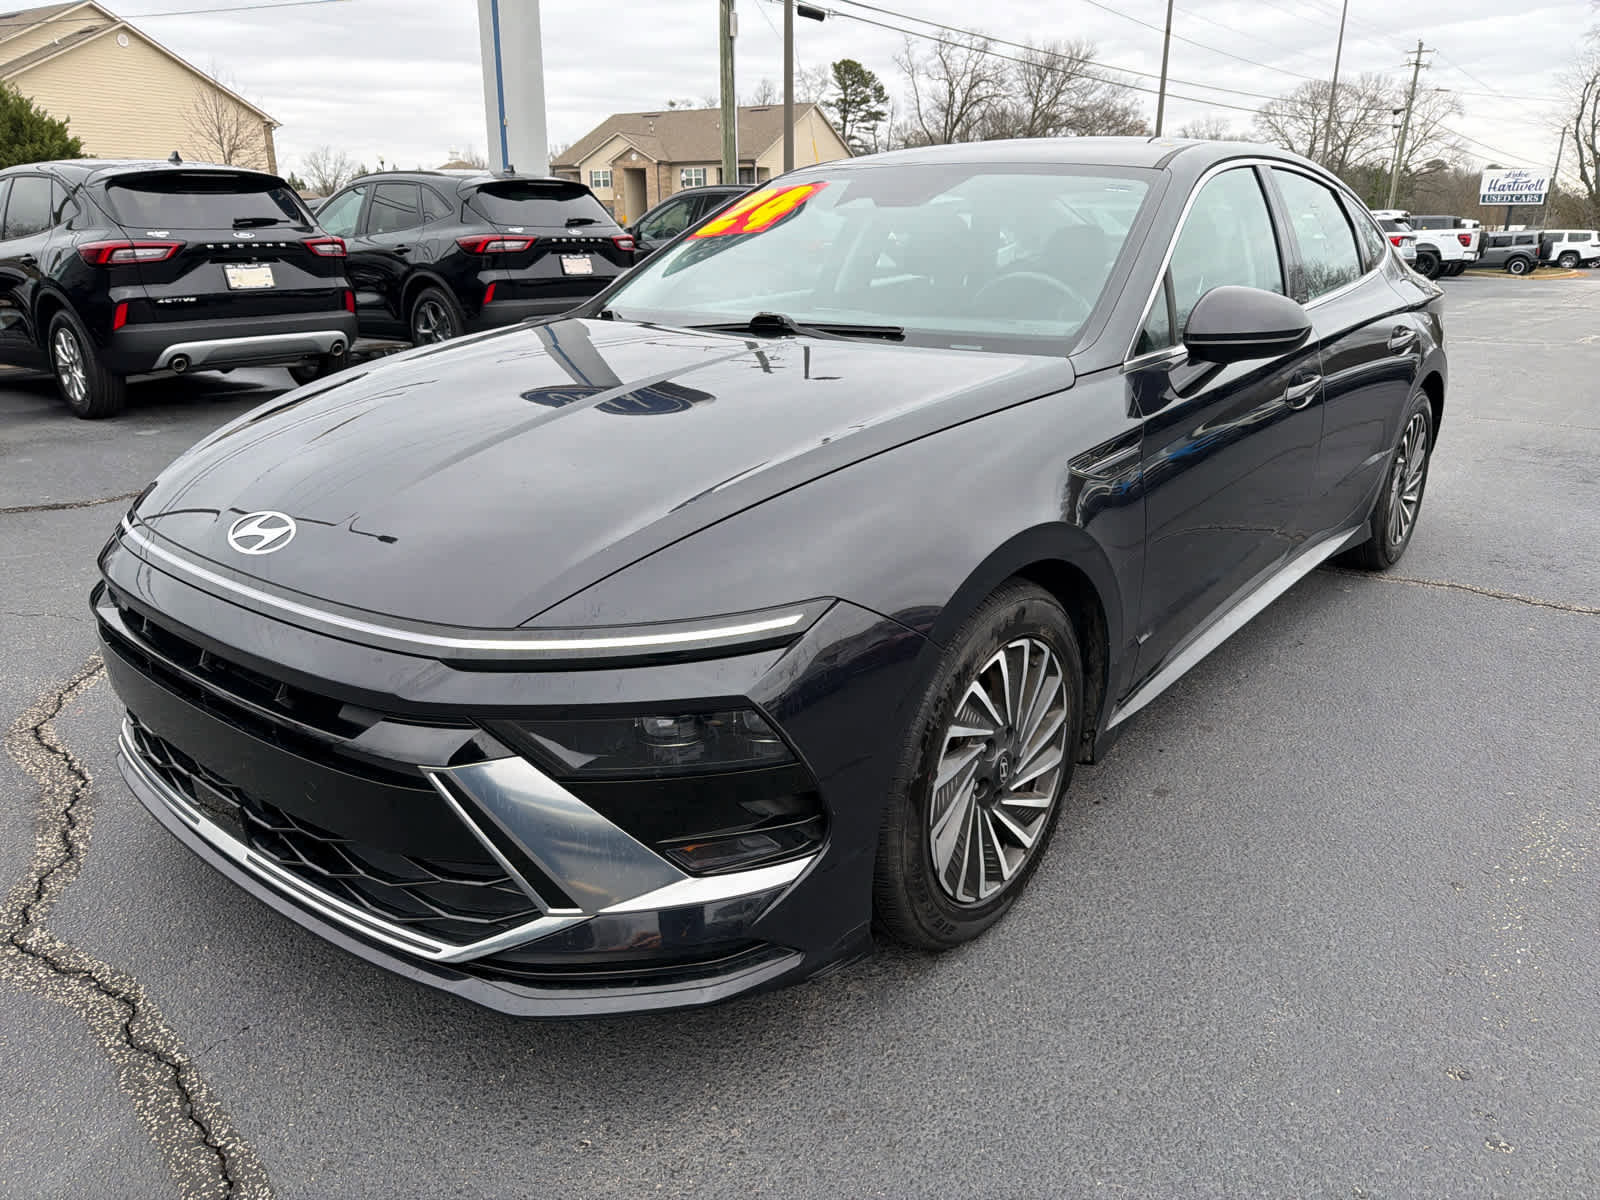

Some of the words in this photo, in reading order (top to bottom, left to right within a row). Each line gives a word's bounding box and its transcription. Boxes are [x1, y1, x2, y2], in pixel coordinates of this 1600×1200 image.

[1488, 178, 1545, 192] Hartwell
[1485, 194, 1511, 202] USED
[1512, 194, 1539, 202] CARS
